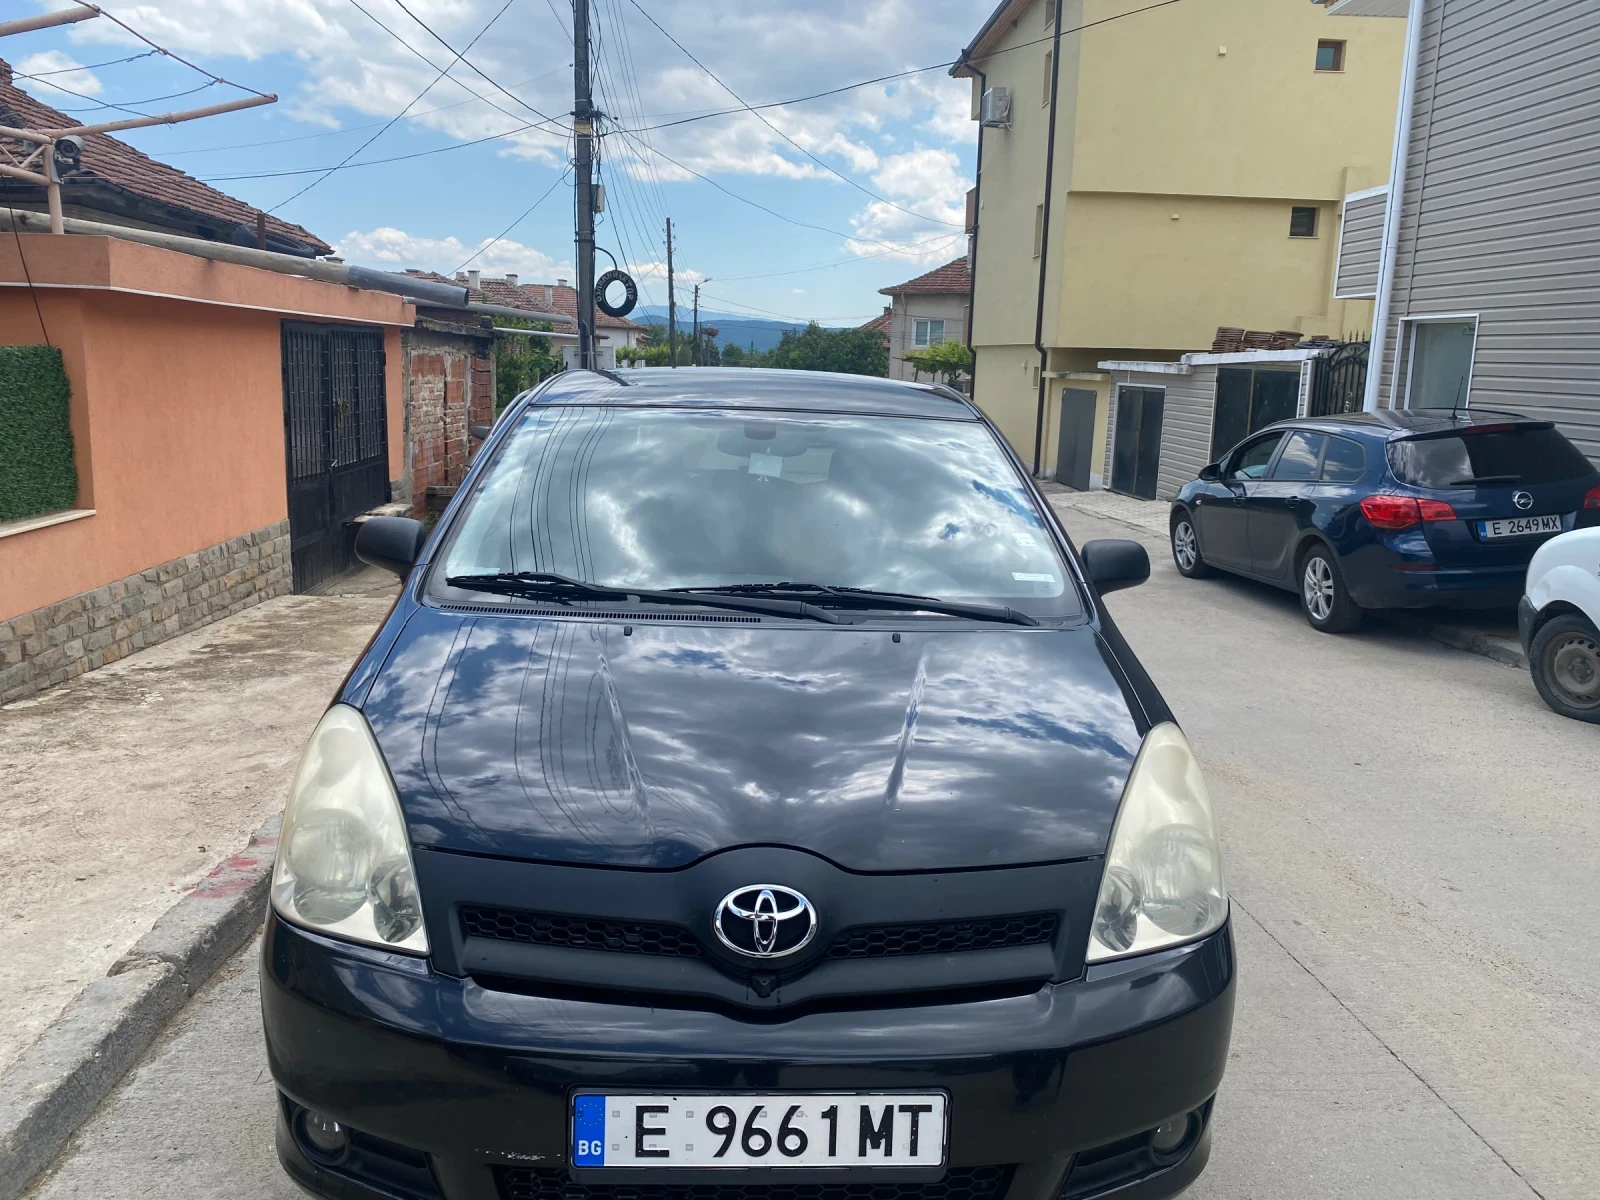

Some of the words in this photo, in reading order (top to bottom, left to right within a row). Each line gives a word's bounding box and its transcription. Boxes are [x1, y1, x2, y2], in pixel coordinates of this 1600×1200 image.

[1492, 522, 1502, 535] E
[1508, 519, 1539, 533] 2649
[1541, 516, 1559, 530] MX
[634, 1104, 670, 1158] E
[704, 1104, 838, 1158] 9661
[857, 1104, 933, 1158] MT
[578, 1139, 602, 1156] BG
